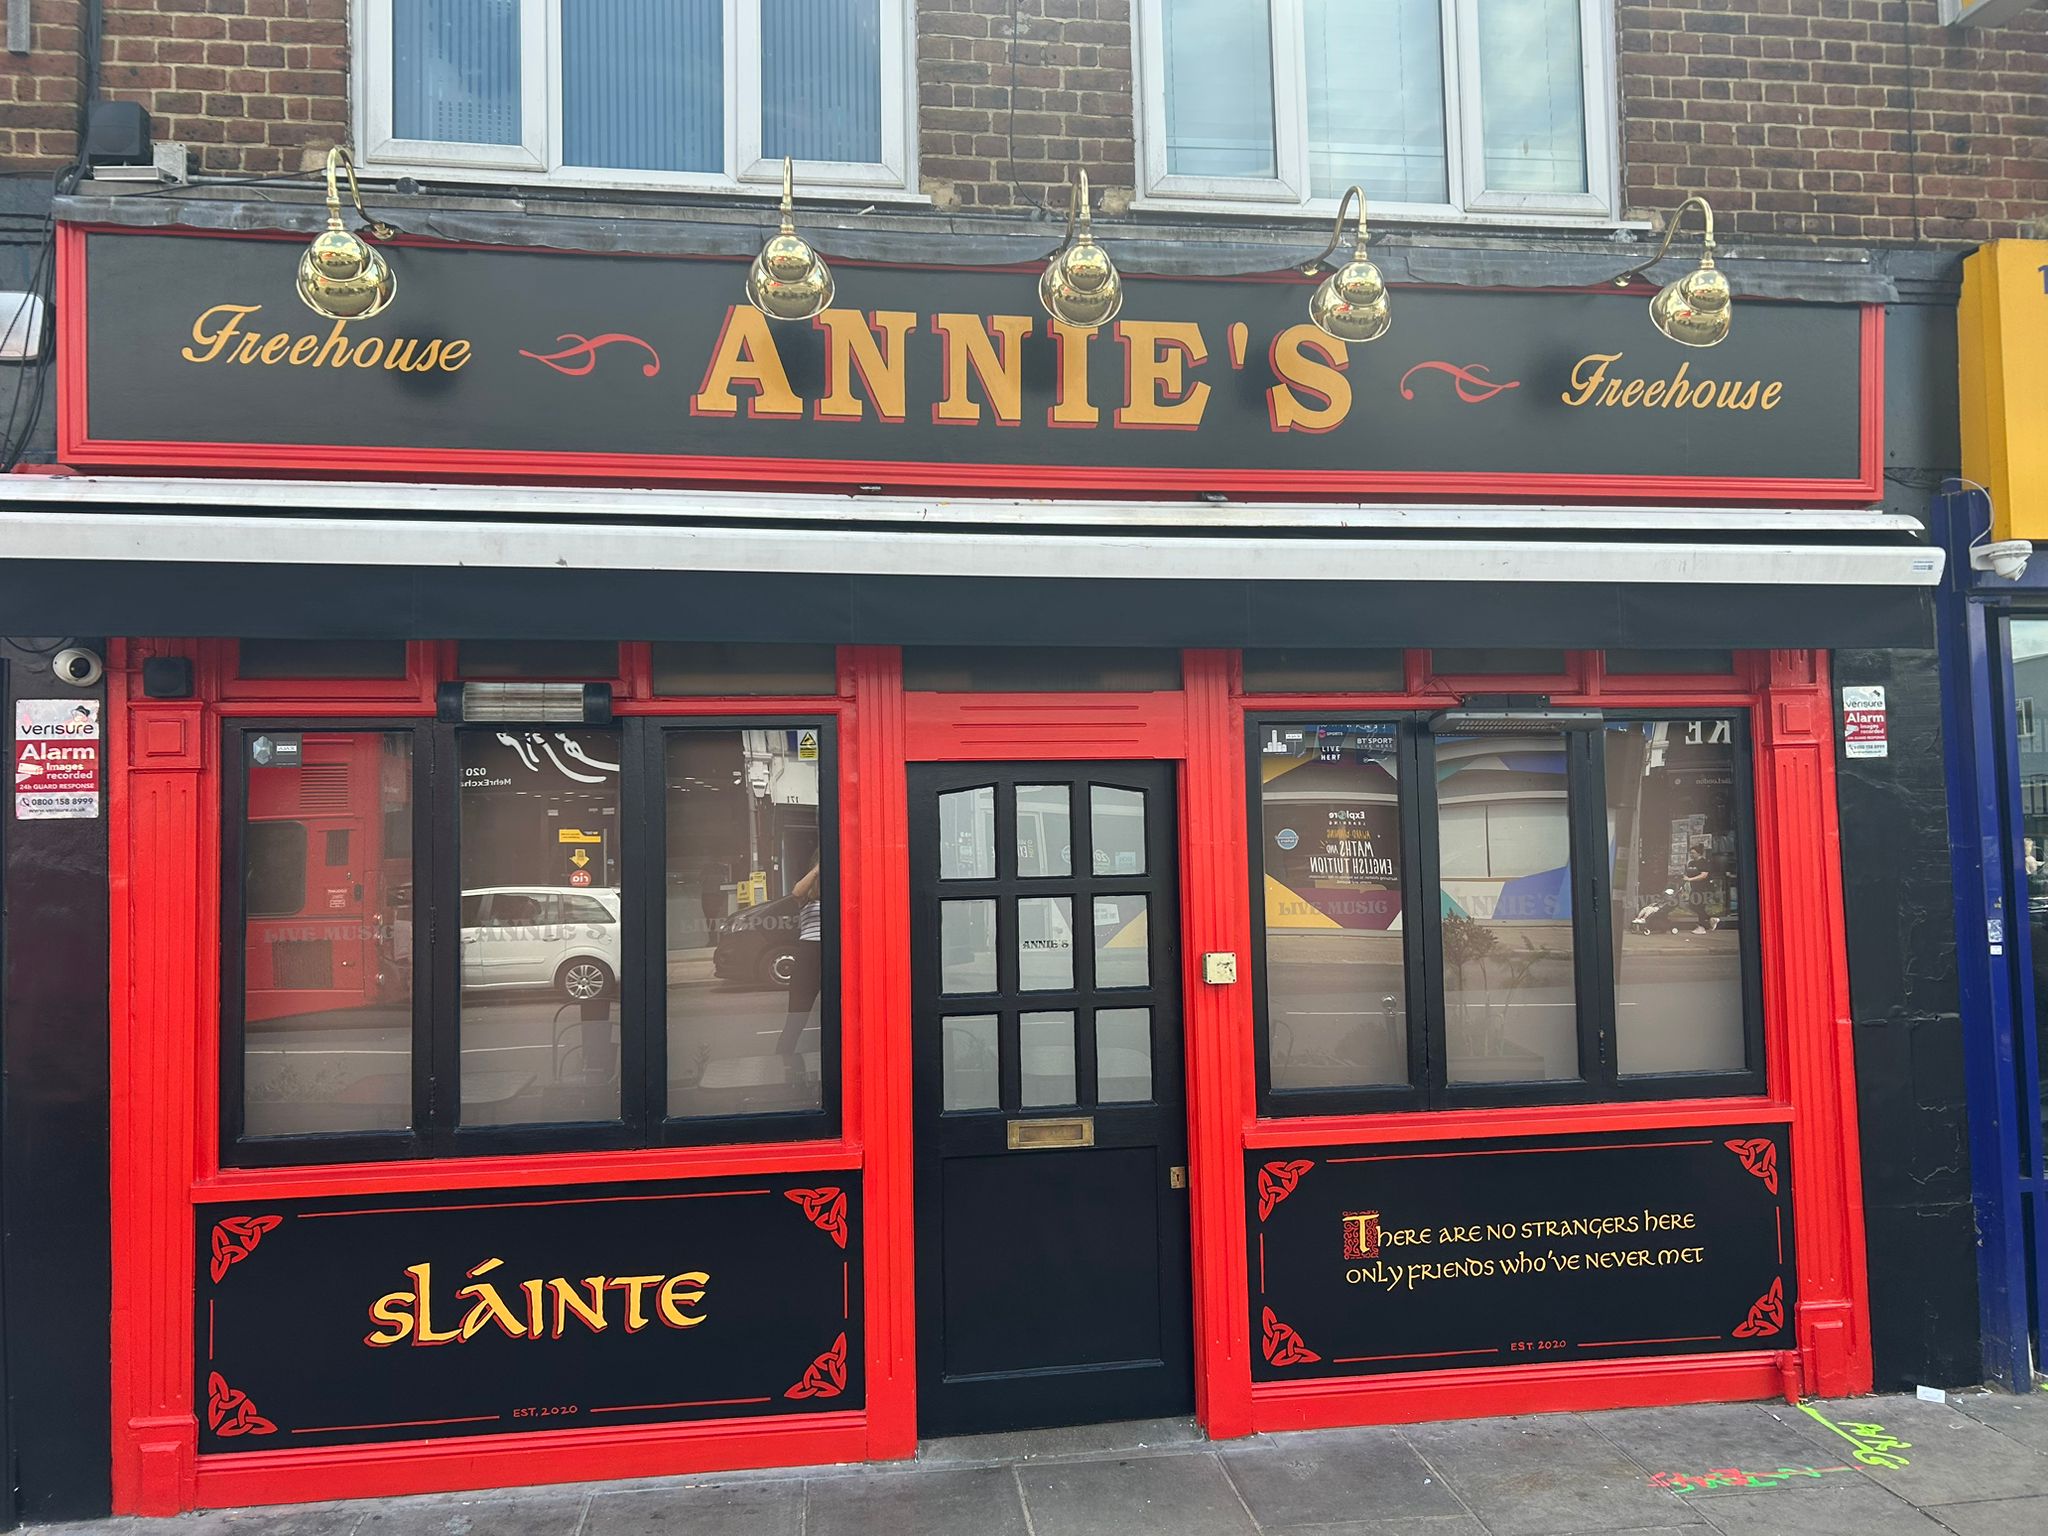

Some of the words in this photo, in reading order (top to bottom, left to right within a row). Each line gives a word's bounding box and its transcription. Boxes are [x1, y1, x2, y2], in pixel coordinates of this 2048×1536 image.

[181, 303, 472, 373] Freehouse
[690, 304, 1353, 433] ANNIE'S
[1561, 351, 1783, 411] Freehouse
[1846, 712, 1884, 723] Alarm
[21, 724, 94, 735] verisure
[20, 742, 95, 760] Alarm
[46, 763, 84, 773] Images
[46, 771, 93, 780] recorded
[32, 798, 53, 806] 0800
[56, 798, 70, 806] 158
[72, 797, 94, 806] 8999
[1279, 901, 1323, 916] LIVE
[1328, 899, 1388, 915] MUSIC
[263, 926, 318, 943] LIVE
[324, 924, 394, 941] MUSIC
[475, 920, 607, 942] ANNIES
[1022, 939, 1069, 950] ANNIE'S
[1537, 1339, 1567, 1350] 2020
[541, 1404, 578, 1416] 2020
